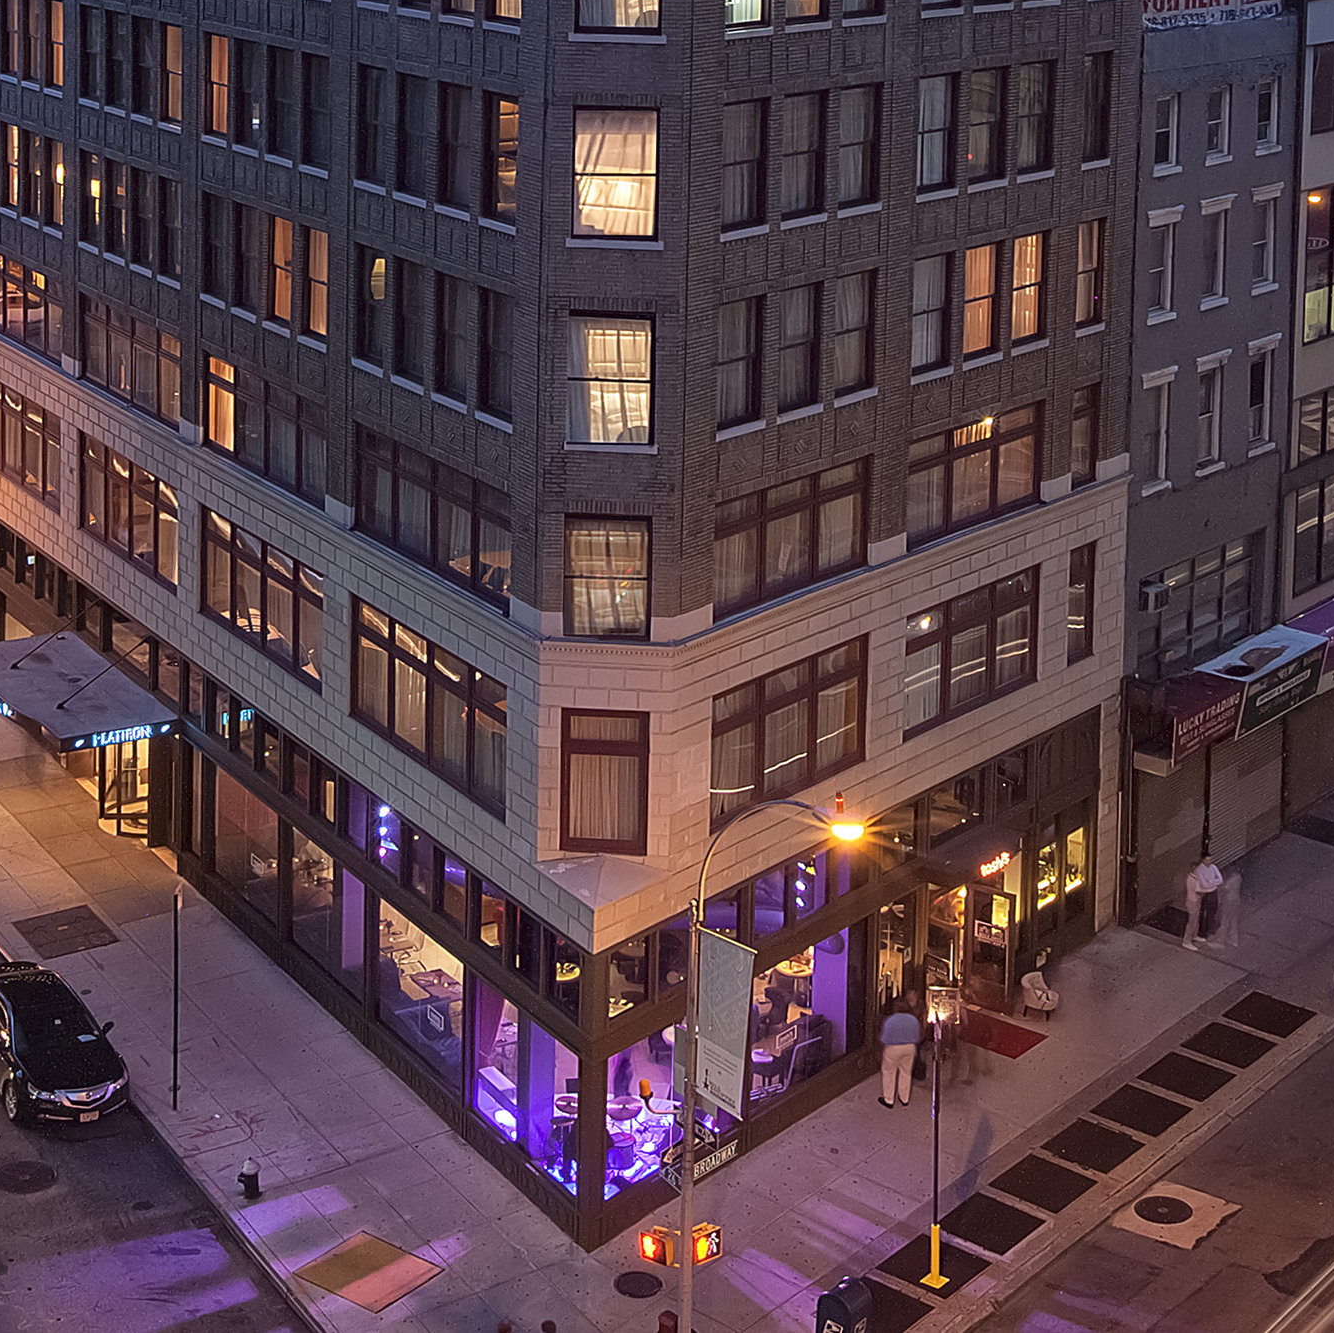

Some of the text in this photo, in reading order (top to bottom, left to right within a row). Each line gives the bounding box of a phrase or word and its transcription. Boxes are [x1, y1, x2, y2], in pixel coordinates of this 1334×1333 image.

[1178, 711, 1205, 736] LUCKY
[1205, 692, 1241, 722] TRADING
[694, 1143, 737, 1177] BROADWAY
